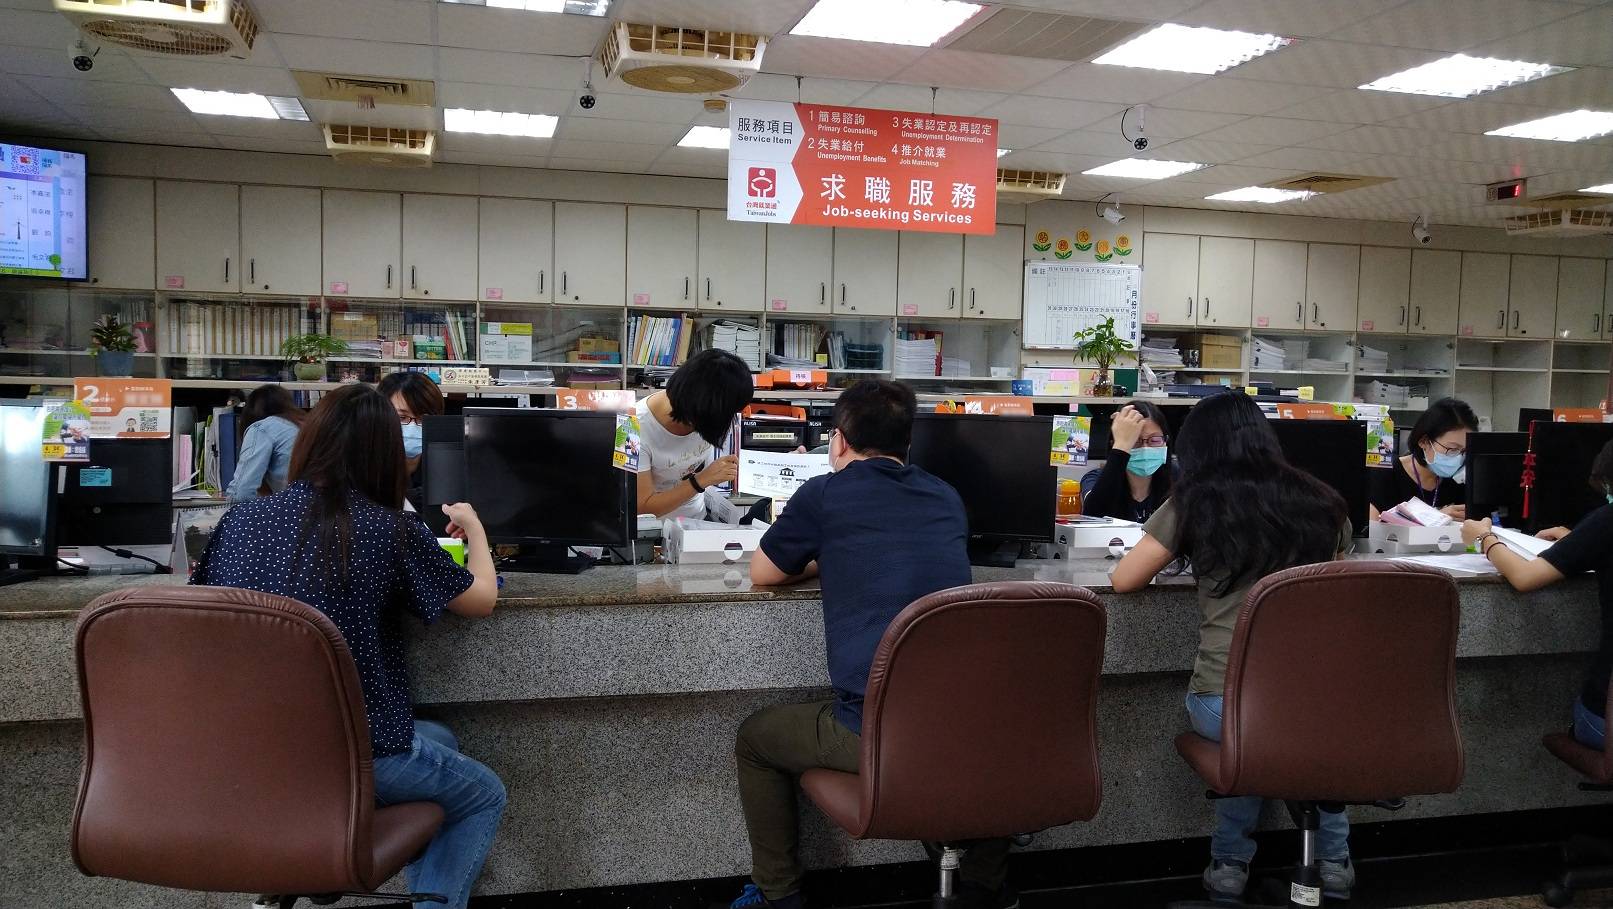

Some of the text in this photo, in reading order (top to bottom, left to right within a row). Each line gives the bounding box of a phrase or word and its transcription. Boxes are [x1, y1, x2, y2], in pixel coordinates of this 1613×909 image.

[738, 117, 793, 135] 服務項目
[808, 111, 865, 126] 1 簡易諮詢
[817, 125, 878, 136] Primary Counselling
[892, 117, 992, 136] 3 失業認定及再認定
[738, 134, 792, 144] Service Item
[808, 137, 865, 152] 2 失業給付
[901, 131, 984, 144] Unemployment Determination
[817, 152, 887, 163] Unemployment Benefits
[891, 144, 946, 159] 4 推介就業
[911, 160, 940, 168] Matching
[820, 173, 976, 209] 求職服務
[822, 205, 972, 224] Job-seeking Services
[83, 385, 99, 403] 2
[564, 395, 577, 410] 3
